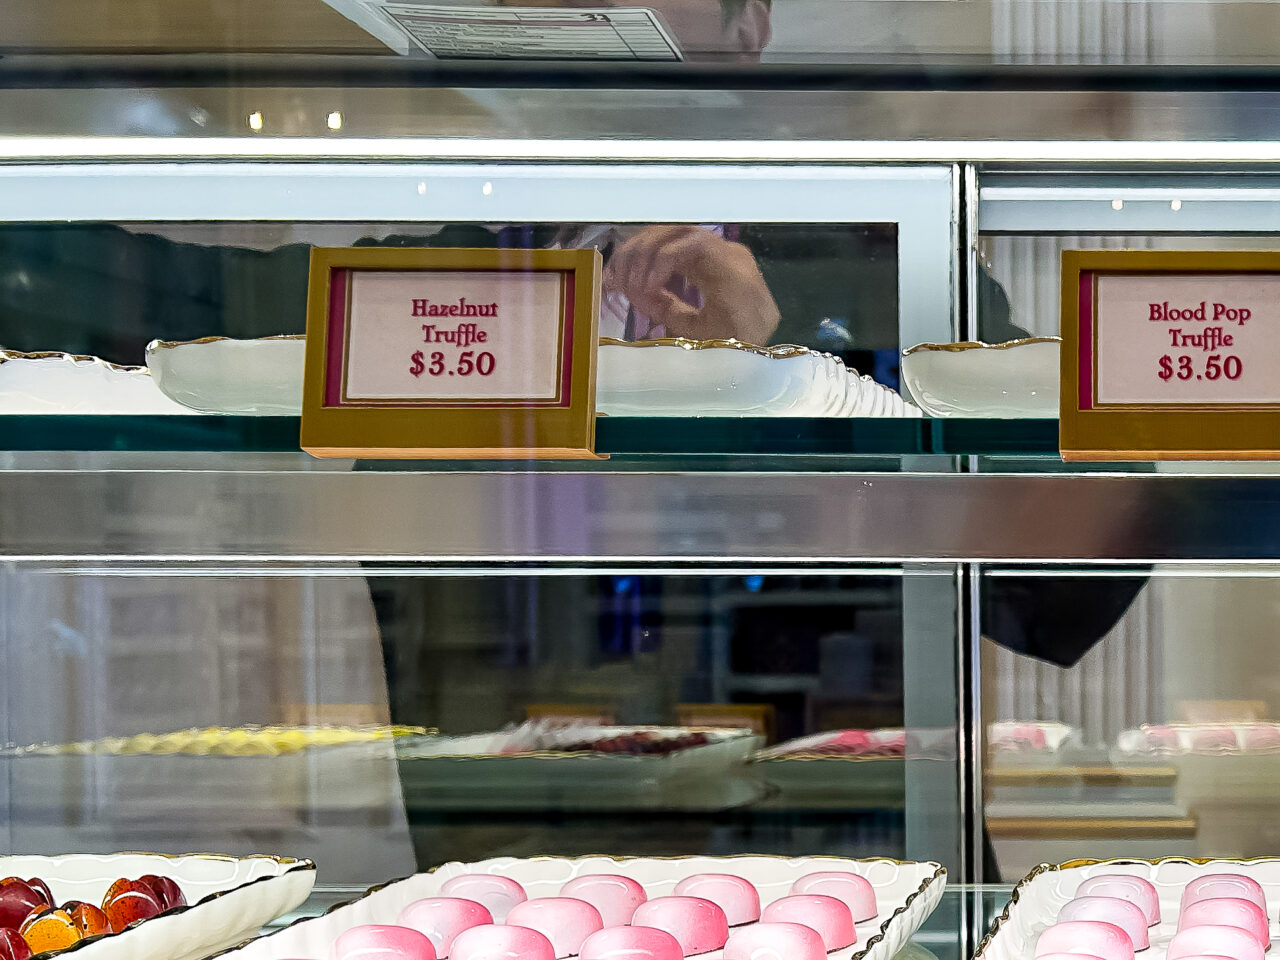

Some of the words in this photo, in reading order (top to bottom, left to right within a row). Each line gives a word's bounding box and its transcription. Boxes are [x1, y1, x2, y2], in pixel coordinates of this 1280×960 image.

[411, 297, 498, 317] Hazelnut
[1148, 301, 1207, 321] Blood
[1212, 303, 1252, 325] Pop
[422, 323, 487, 347] Truffle
[1168, 327, 1233, 352] Truffle
[409, 350, 496, 378] $3.50
[1158, 354, 1243, 382] $3.50
